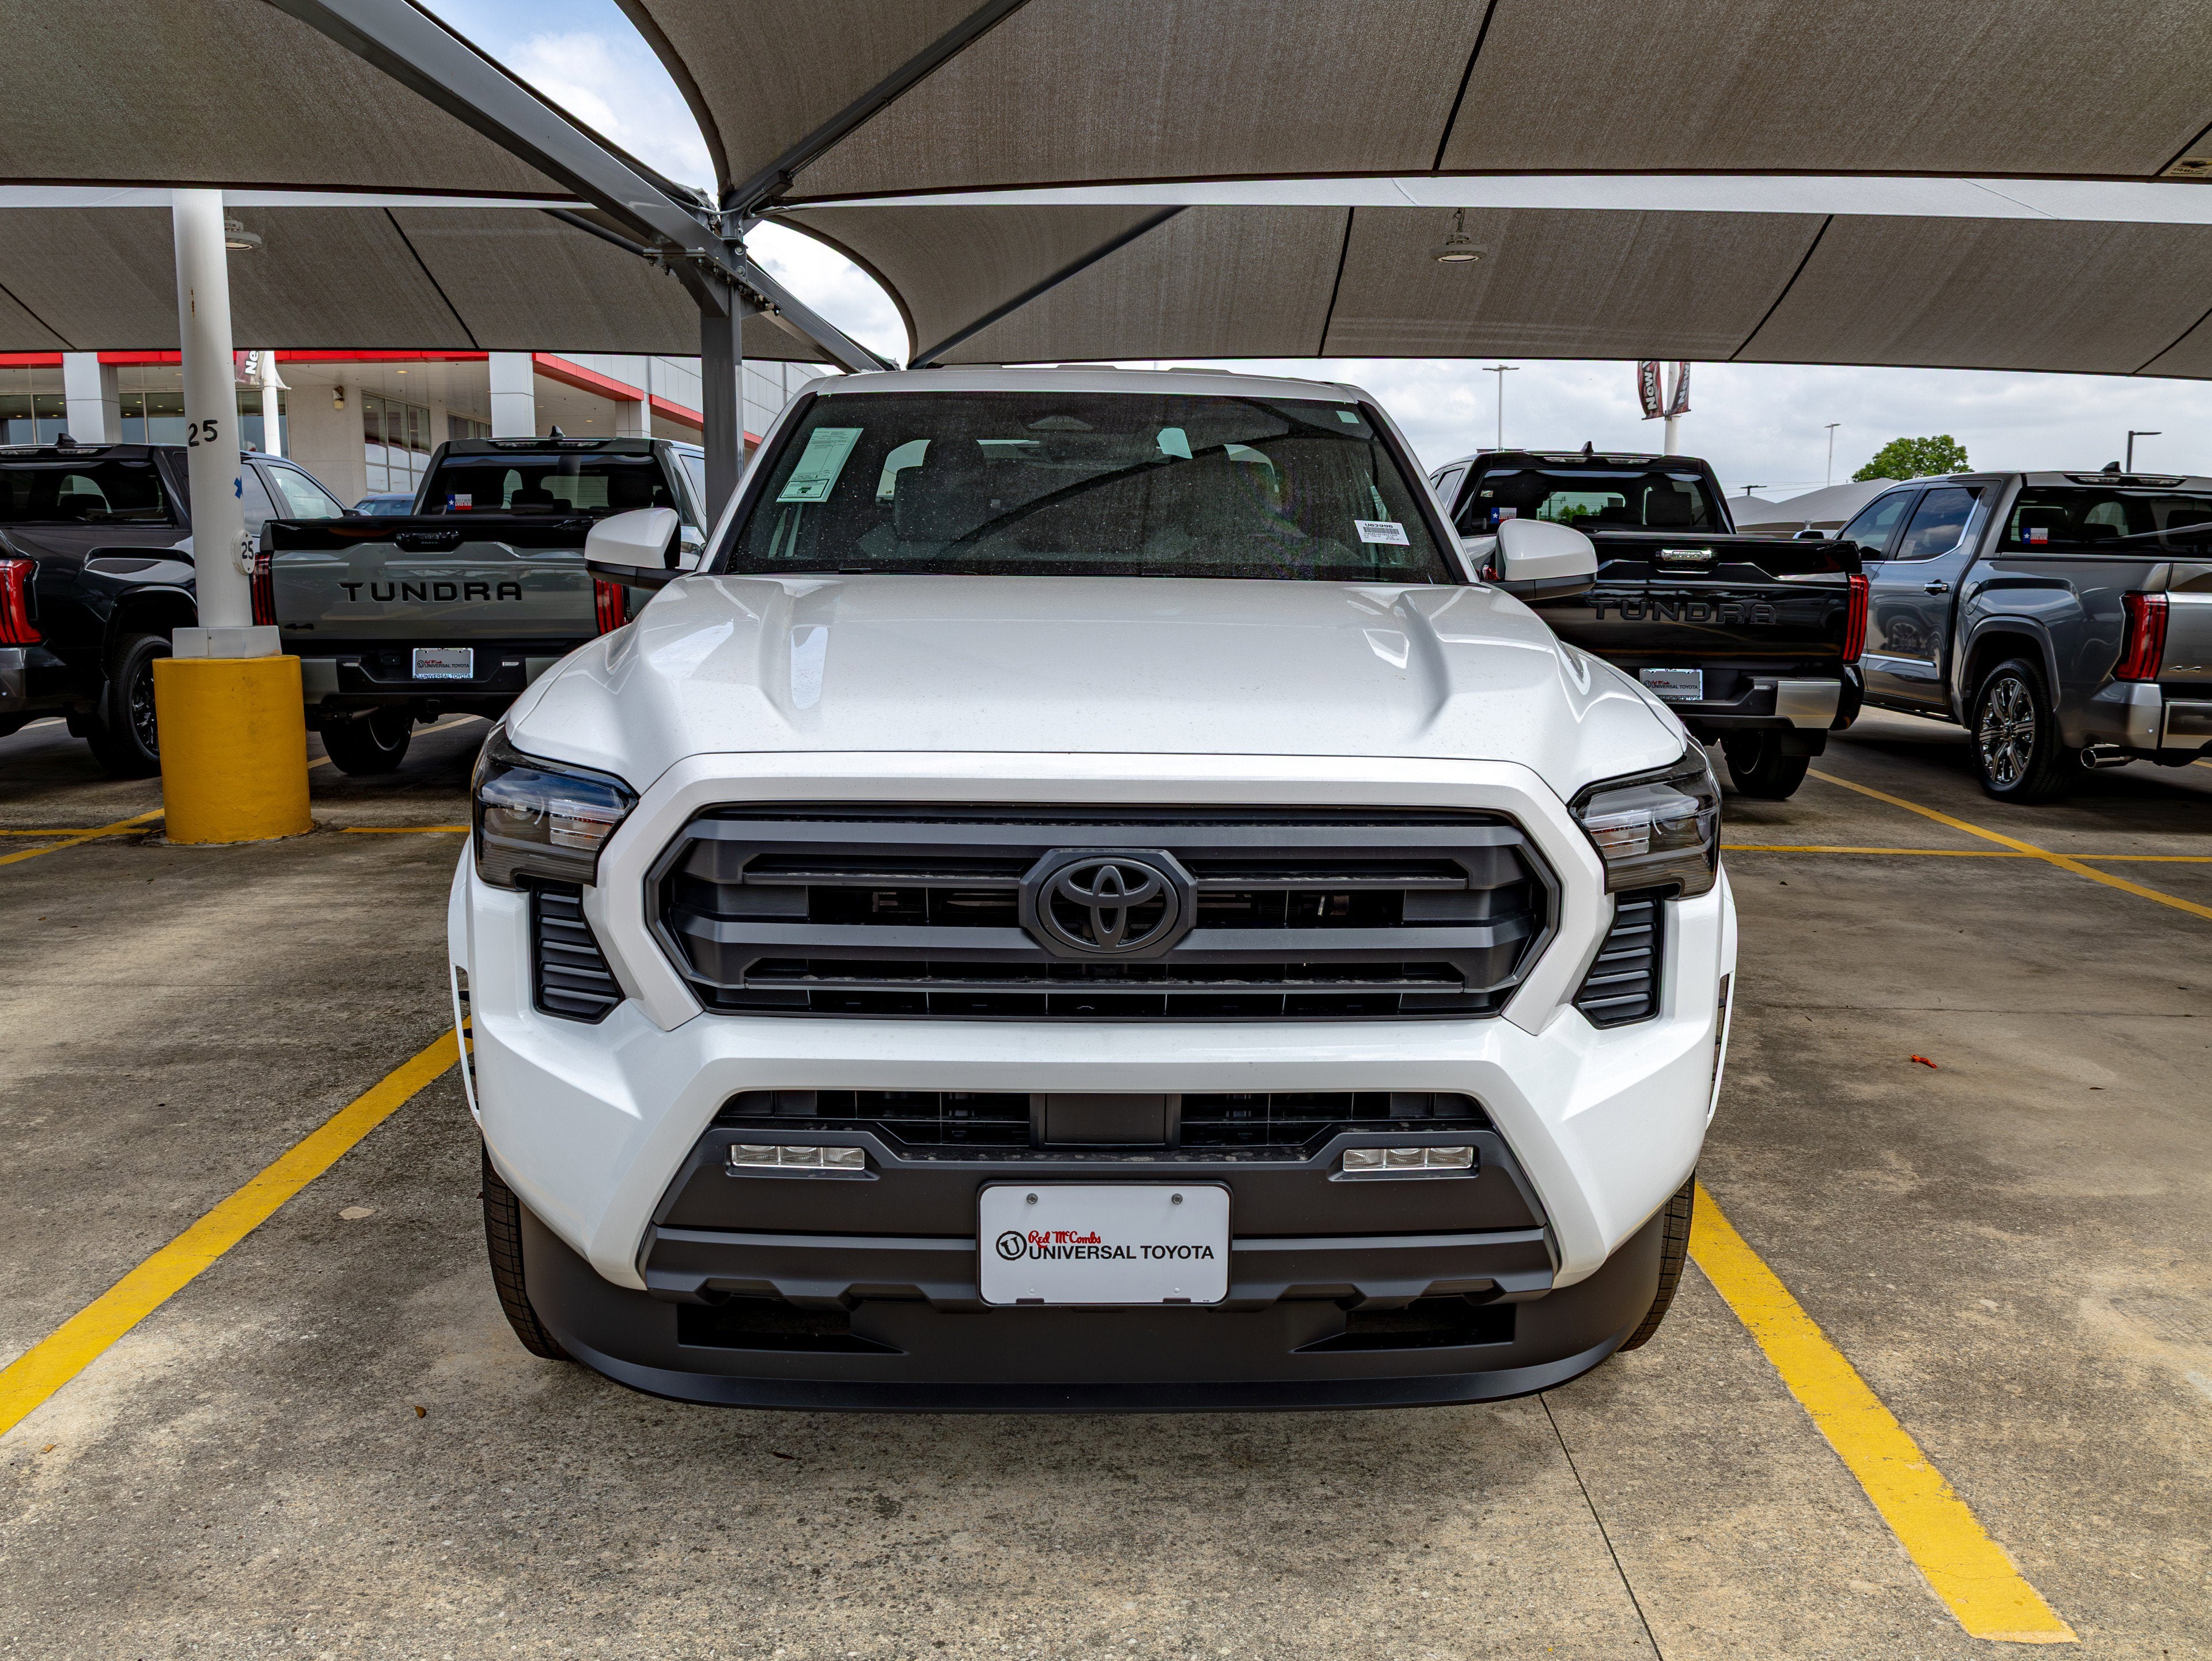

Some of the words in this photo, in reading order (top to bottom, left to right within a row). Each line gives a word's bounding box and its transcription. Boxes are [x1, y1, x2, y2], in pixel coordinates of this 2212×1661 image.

[245, 350, 259, 374] Ne
[1644, 372, 1657, 410] New
[1677, 364, 1690, 404] New
[188, 419, 218, 447] 25
[241, 540, 254, 560] 25
[338, 581, 523, 603] TUNDRA
[1586, 599, 1777, 625] TUNDRA
[1028, 1230, 1051, 1248] Red
[1052, 1231, 1101, 1244] McCombs
[1029, 1246, 1137, 1259] UNIVERSAL
[1140, 1246, 1215, 1259] TOYOTA
